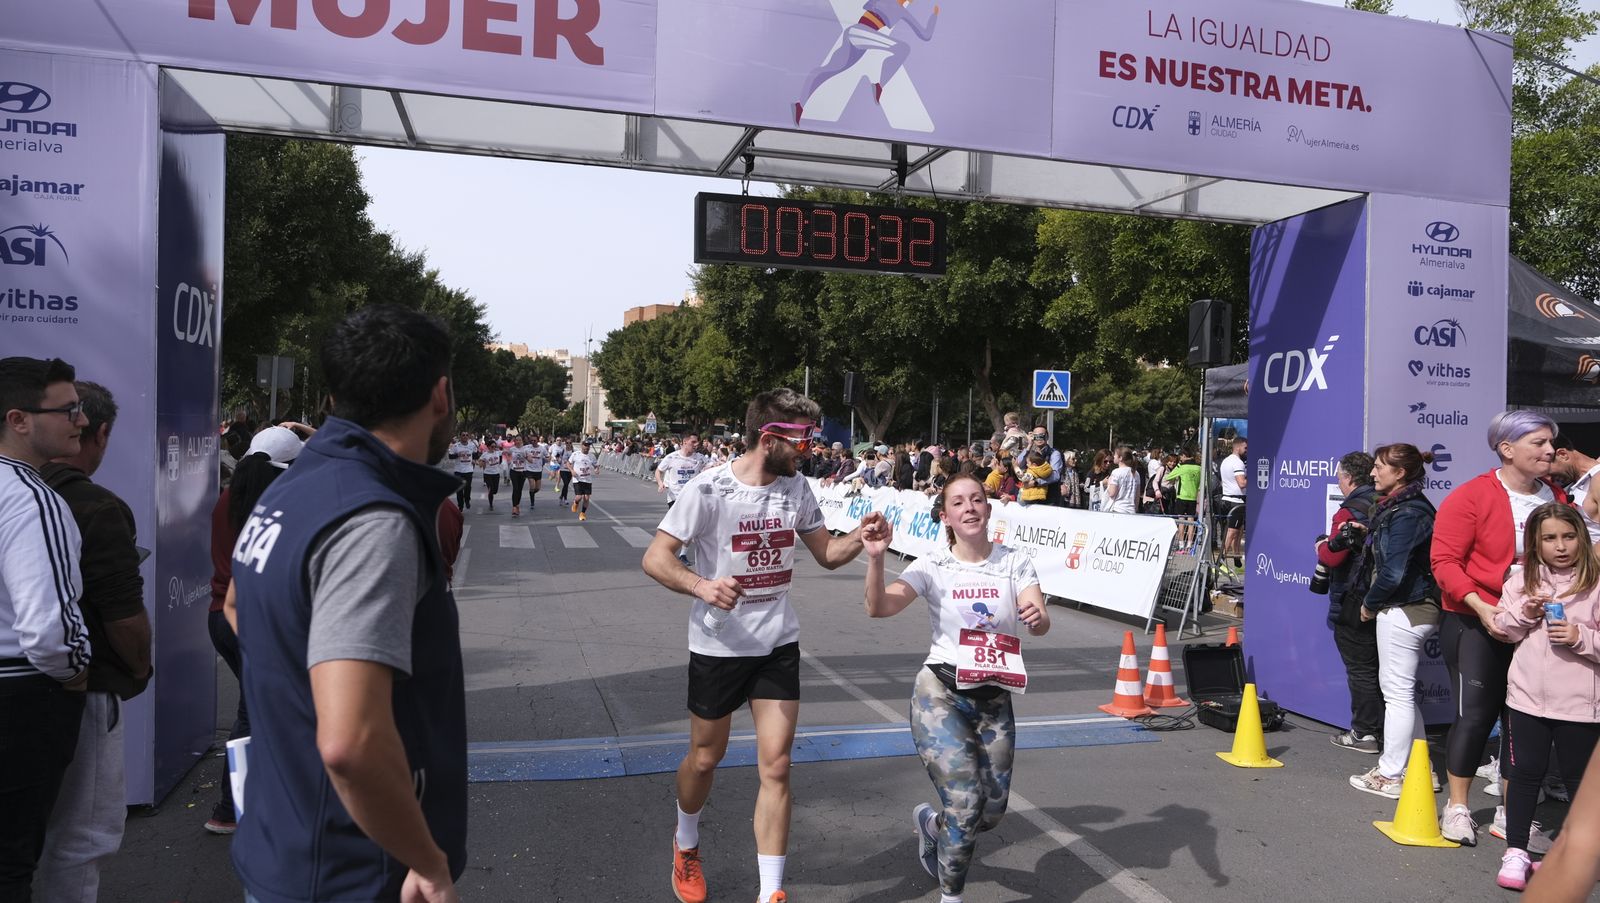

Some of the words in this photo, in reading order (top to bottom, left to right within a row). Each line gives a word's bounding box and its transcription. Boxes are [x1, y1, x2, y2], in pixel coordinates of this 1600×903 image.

[1148, 10, 1182, 40] LA
[1191, 16, 1331, 62] IGUALDAD
[1099, 50, 1137, 81] ES
[1145, 56, 1281, 102] NUESTRA
[1288, 77, 1372, 113] META.
[1112, 105, 1159, 131] CDX
[1211, 114, 1262, 133] ALMERÍA
[1211, 129, 1238, 139] CIUDAD
[741, 203, 934, 267] 00:30:32
[1412, 243, 1472, 259] HYUNDAI
[1420, 257, 1466, 270] Almerialva
[1427, 284, 1475, 299] cajamar
[11, 314, 34, 323] para
[37, 314, 78, 324] cuidarte
[173, 282, 216, 348] CDX
[1414, 325, 1456, 348] CASI
[1264, 340, 1334, 394] CDX
[1427, 363, 1471, 378] vithas
[1417, 411, 1468, 428] aqualia
[1279, 478, 1311, 489] CIUDAD
[1424, 477, 1452, 490] lece
[739, 518, 782, 533] MUJER
[1014, 525, 1067, 549] ALMERÍA
[748, 549, 782, 567] 692
[1094, 537, 1161, 563] ALMERÍA
[1092, 557, 1124, 575] CIUDAD
[952, 588, 1000, 600] MUJER
[974, 646, 1007, 666] 851
